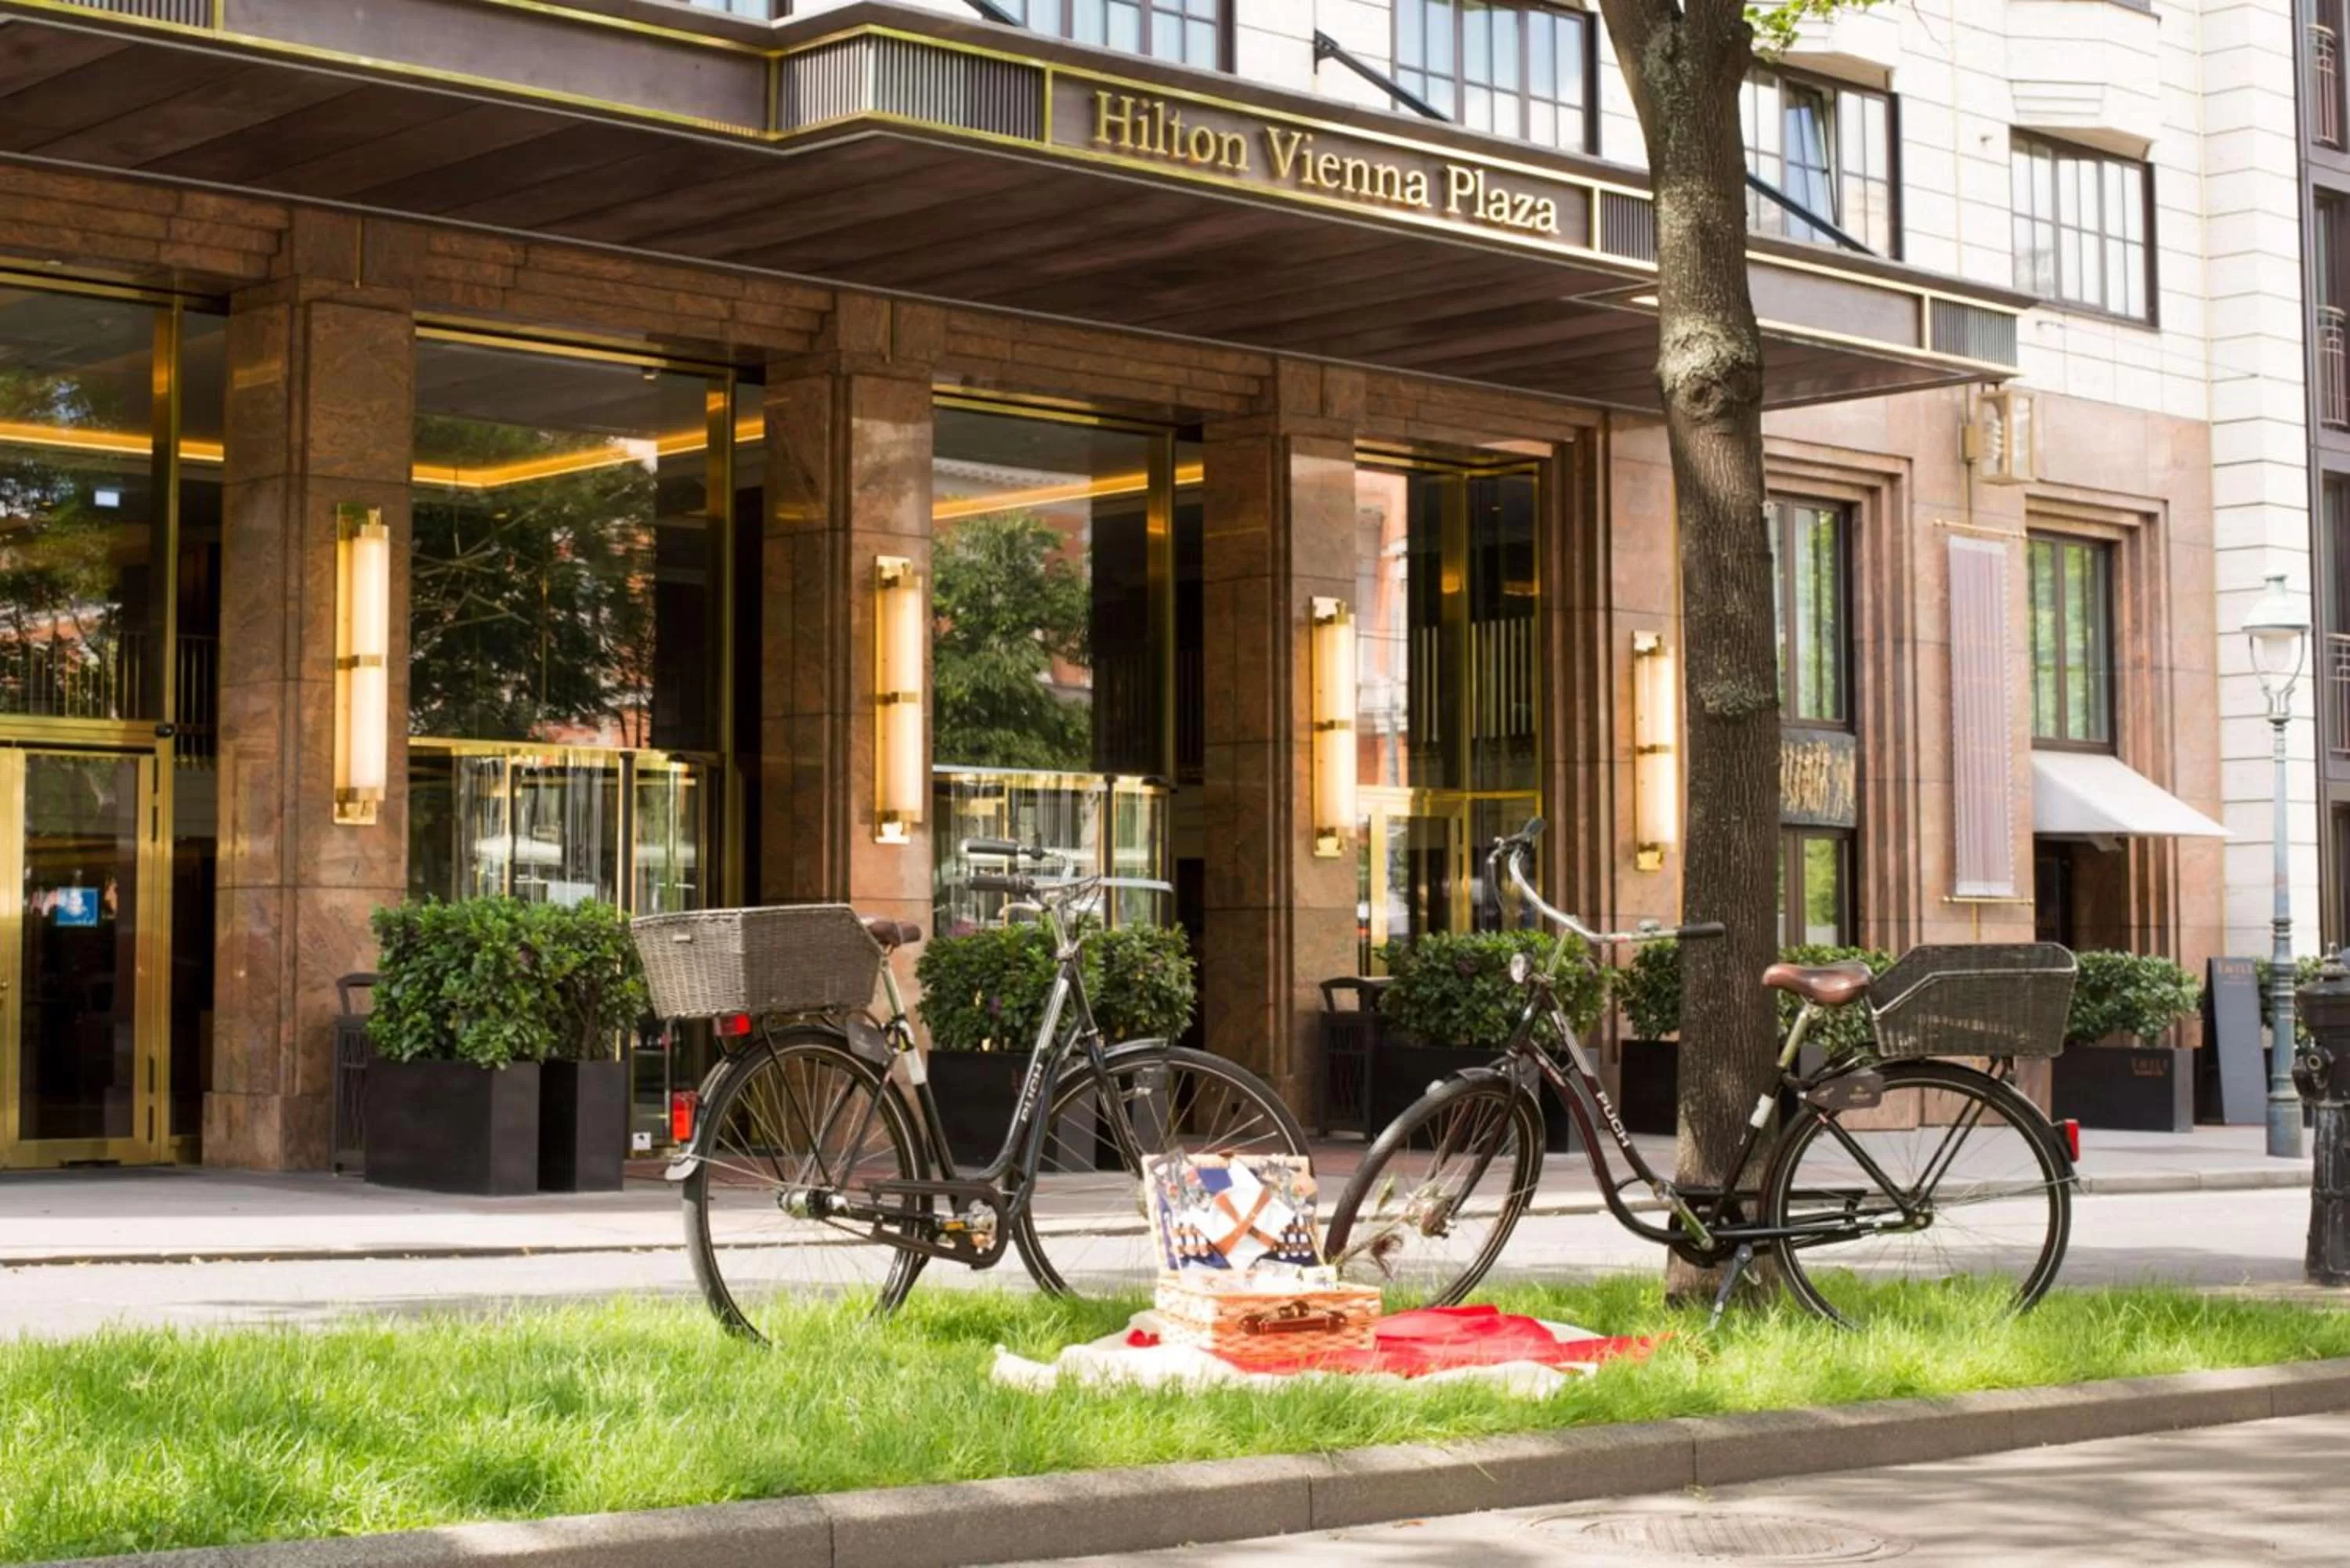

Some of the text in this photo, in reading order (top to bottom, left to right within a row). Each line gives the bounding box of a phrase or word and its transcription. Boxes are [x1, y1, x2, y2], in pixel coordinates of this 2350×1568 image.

[1094, 89, 1561, 234] Hilton Vienna Plaza
[1596, 1090, 1631, 1148] PUCH
